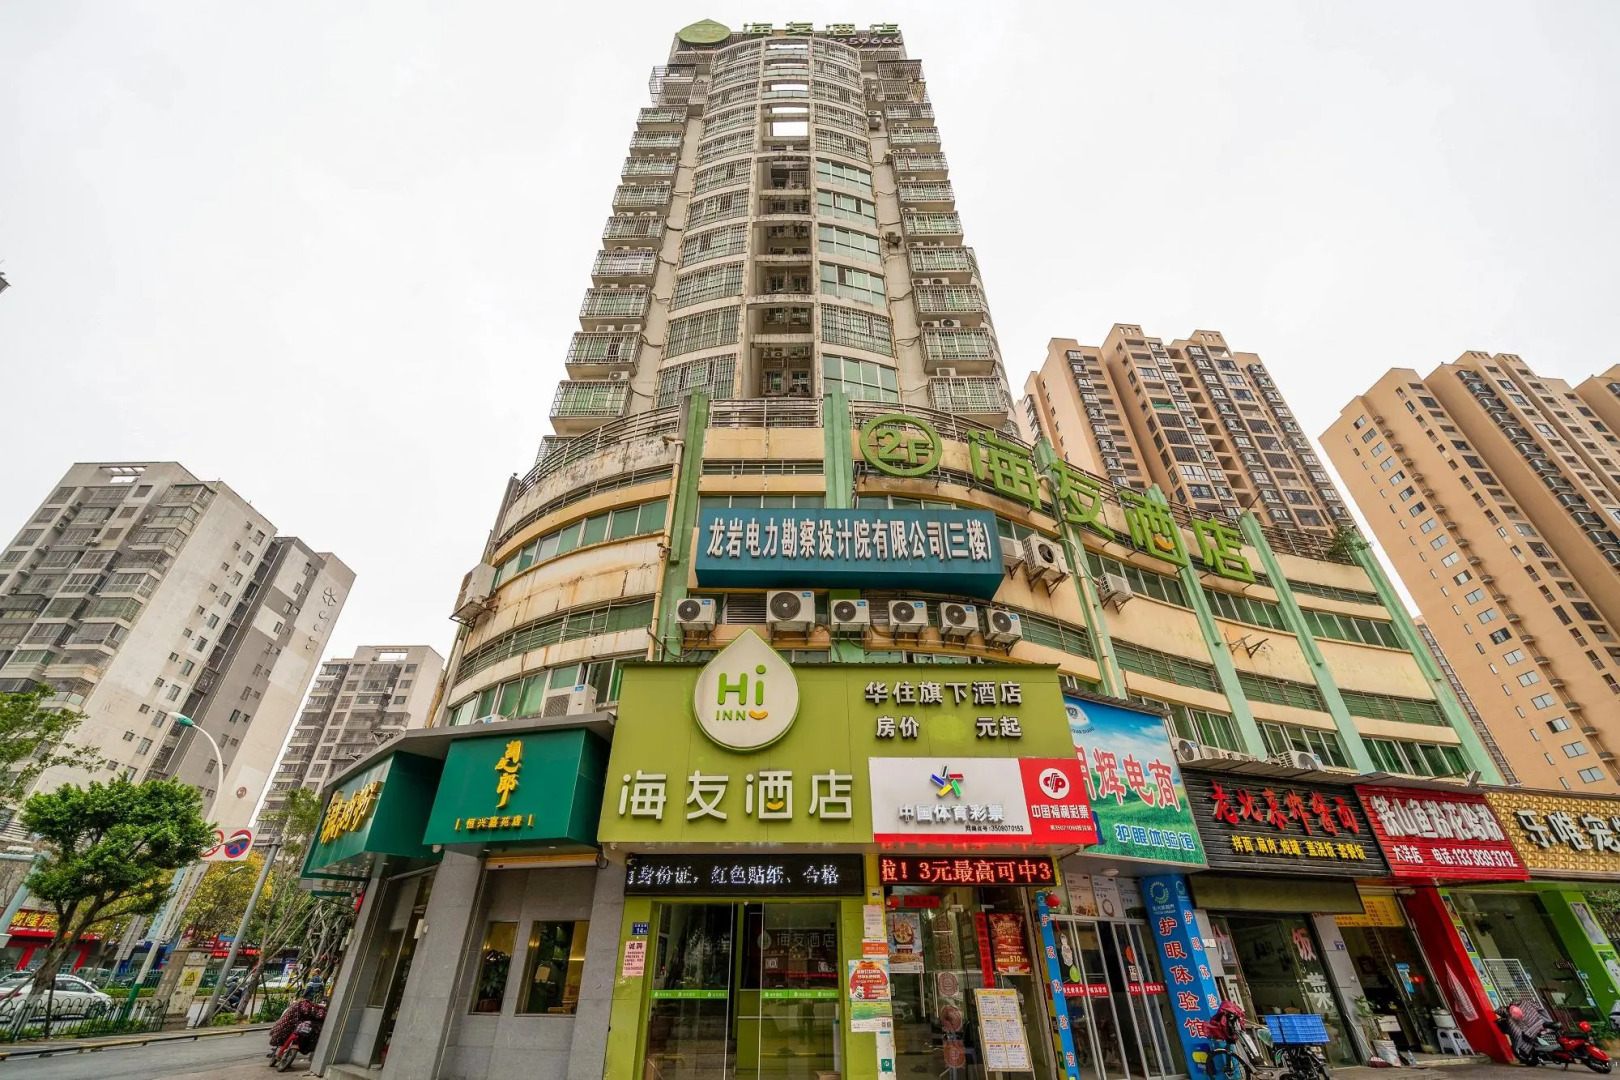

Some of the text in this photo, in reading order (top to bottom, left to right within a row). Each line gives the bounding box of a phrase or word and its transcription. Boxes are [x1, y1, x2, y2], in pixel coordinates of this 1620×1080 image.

[743, 22, 899, 36] 海友酒店
[876, 428, 930, 465] 2F
[968, 428, 1256, 584] 海友酒店
[706, 517, 992, 561] 龙岩电力勘察设计院有限公司(三楼)
[717, 664, 767, 706] Hi
[865, 681, 1022, 704] 华住旗下酒店
[716, 710, 746, 721] INN
[876, 716, 1022, 738] 房价 元起
[618, 769, 853, 820] 海友酒店
[1210, 780, 1360, 836] 老北京炸酱面
[899, 804, 1004, 823] 中国体育彩票
[1031, 804, 1090, 819] 中国福利彩票
[1370, 795, 1505, 841] 铁山鱼粉花蛤粉
[1115, 823, 1196, 851] 护眼体验馆
[1392, 845, 1424, 864] 大洋店
[777, 932, 835, 949] 海友酒店
[1159, 917, 1208, 1038] 护眼体验馆
